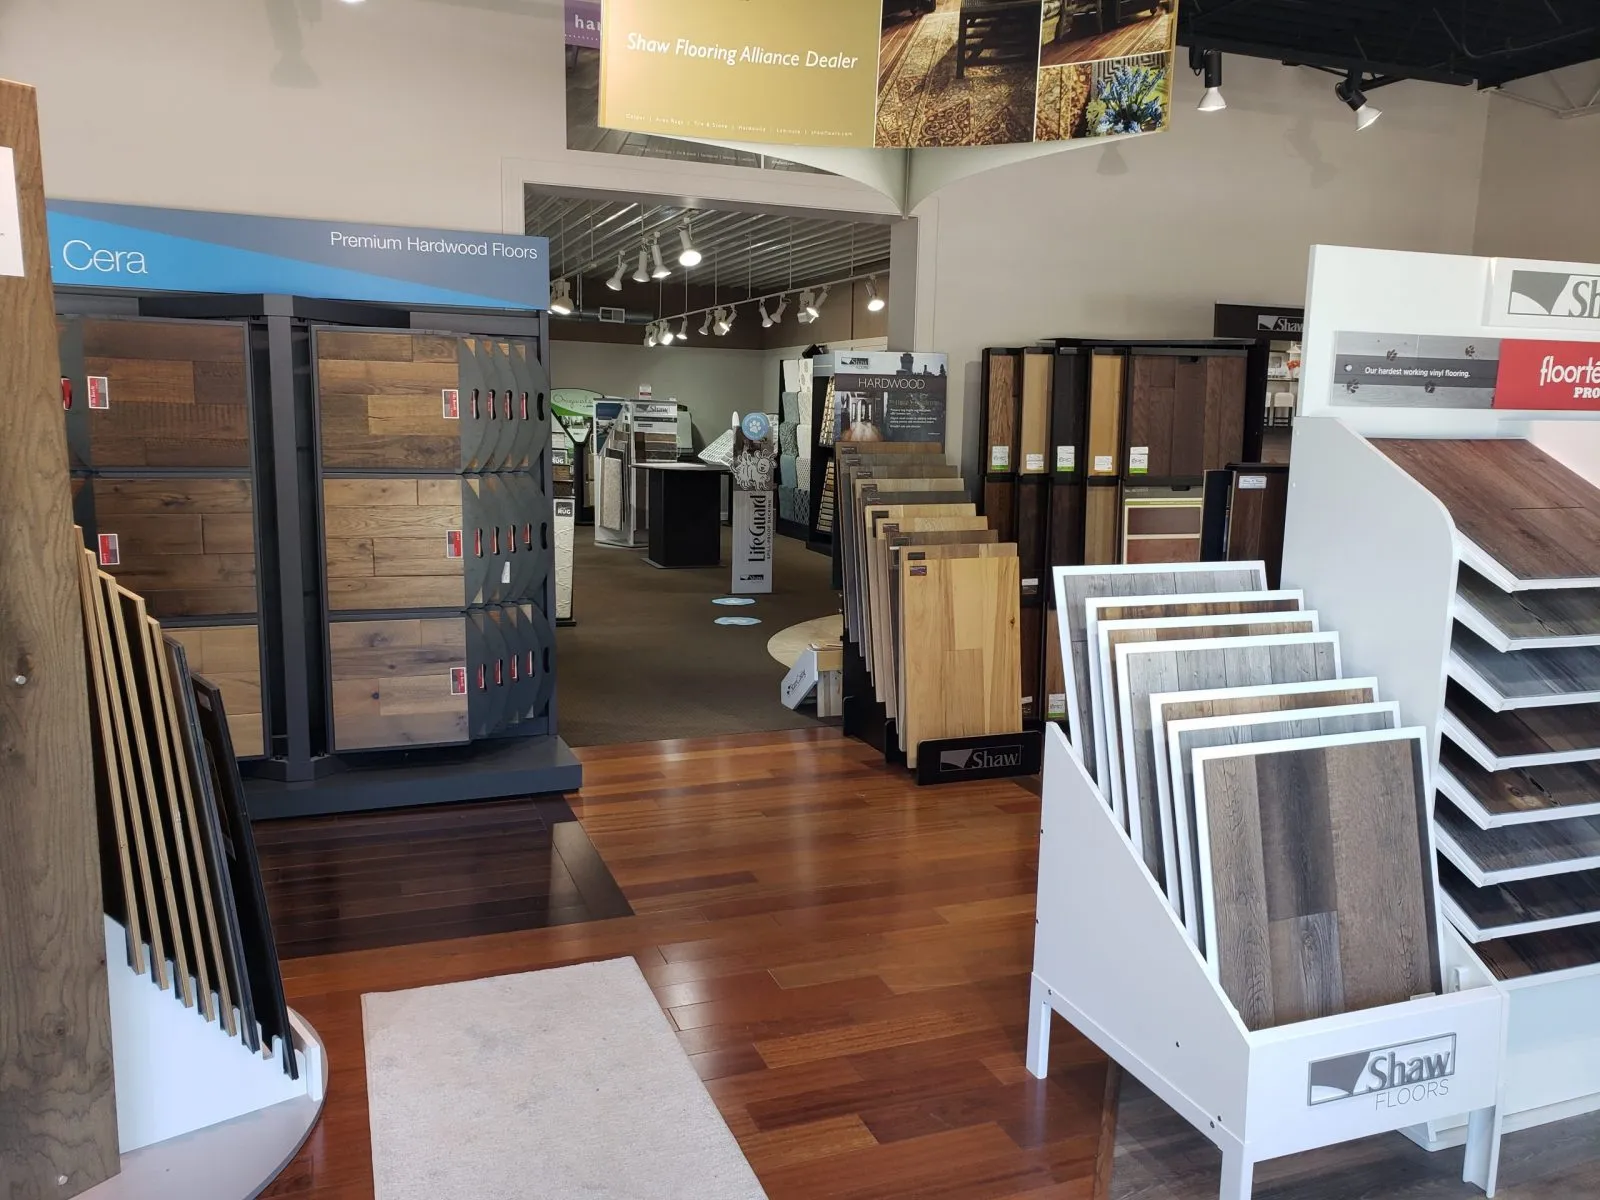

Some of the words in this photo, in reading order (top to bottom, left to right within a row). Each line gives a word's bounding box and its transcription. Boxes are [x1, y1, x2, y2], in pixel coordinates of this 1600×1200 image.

[627, 32, 670, 53] Shaw
[675, 38, 737, 66] Flooring
[740, 45, 800, 67] Alliance
[805, 50, 858, 69] Dealer
[62, 239, 148, 274] Cera
[330, 231, 402, 250] Premium
[407, 236, 488, 256] Hardwood
[492, 242, 538, 260] Floors
[858, 378, 926, 390] HARDWOOD
[1364, 366, 1378, 375] Our
[1378, 367, 1402, 376] hardest
[1403, 368, 1429, 378] working
[1429, 369, 1444, 378] vinyl
[1445, 369, 1471, 379] flooring.
[1573, 386, 1600, 399] PRO
[748, 494, 766, 562] LifeGuard
[971, 750, 1018, 769] Shaw
[1367, 1050, 1451, 1093] Shaw
[1375, 1078, 1449, 1111] FLOORS
